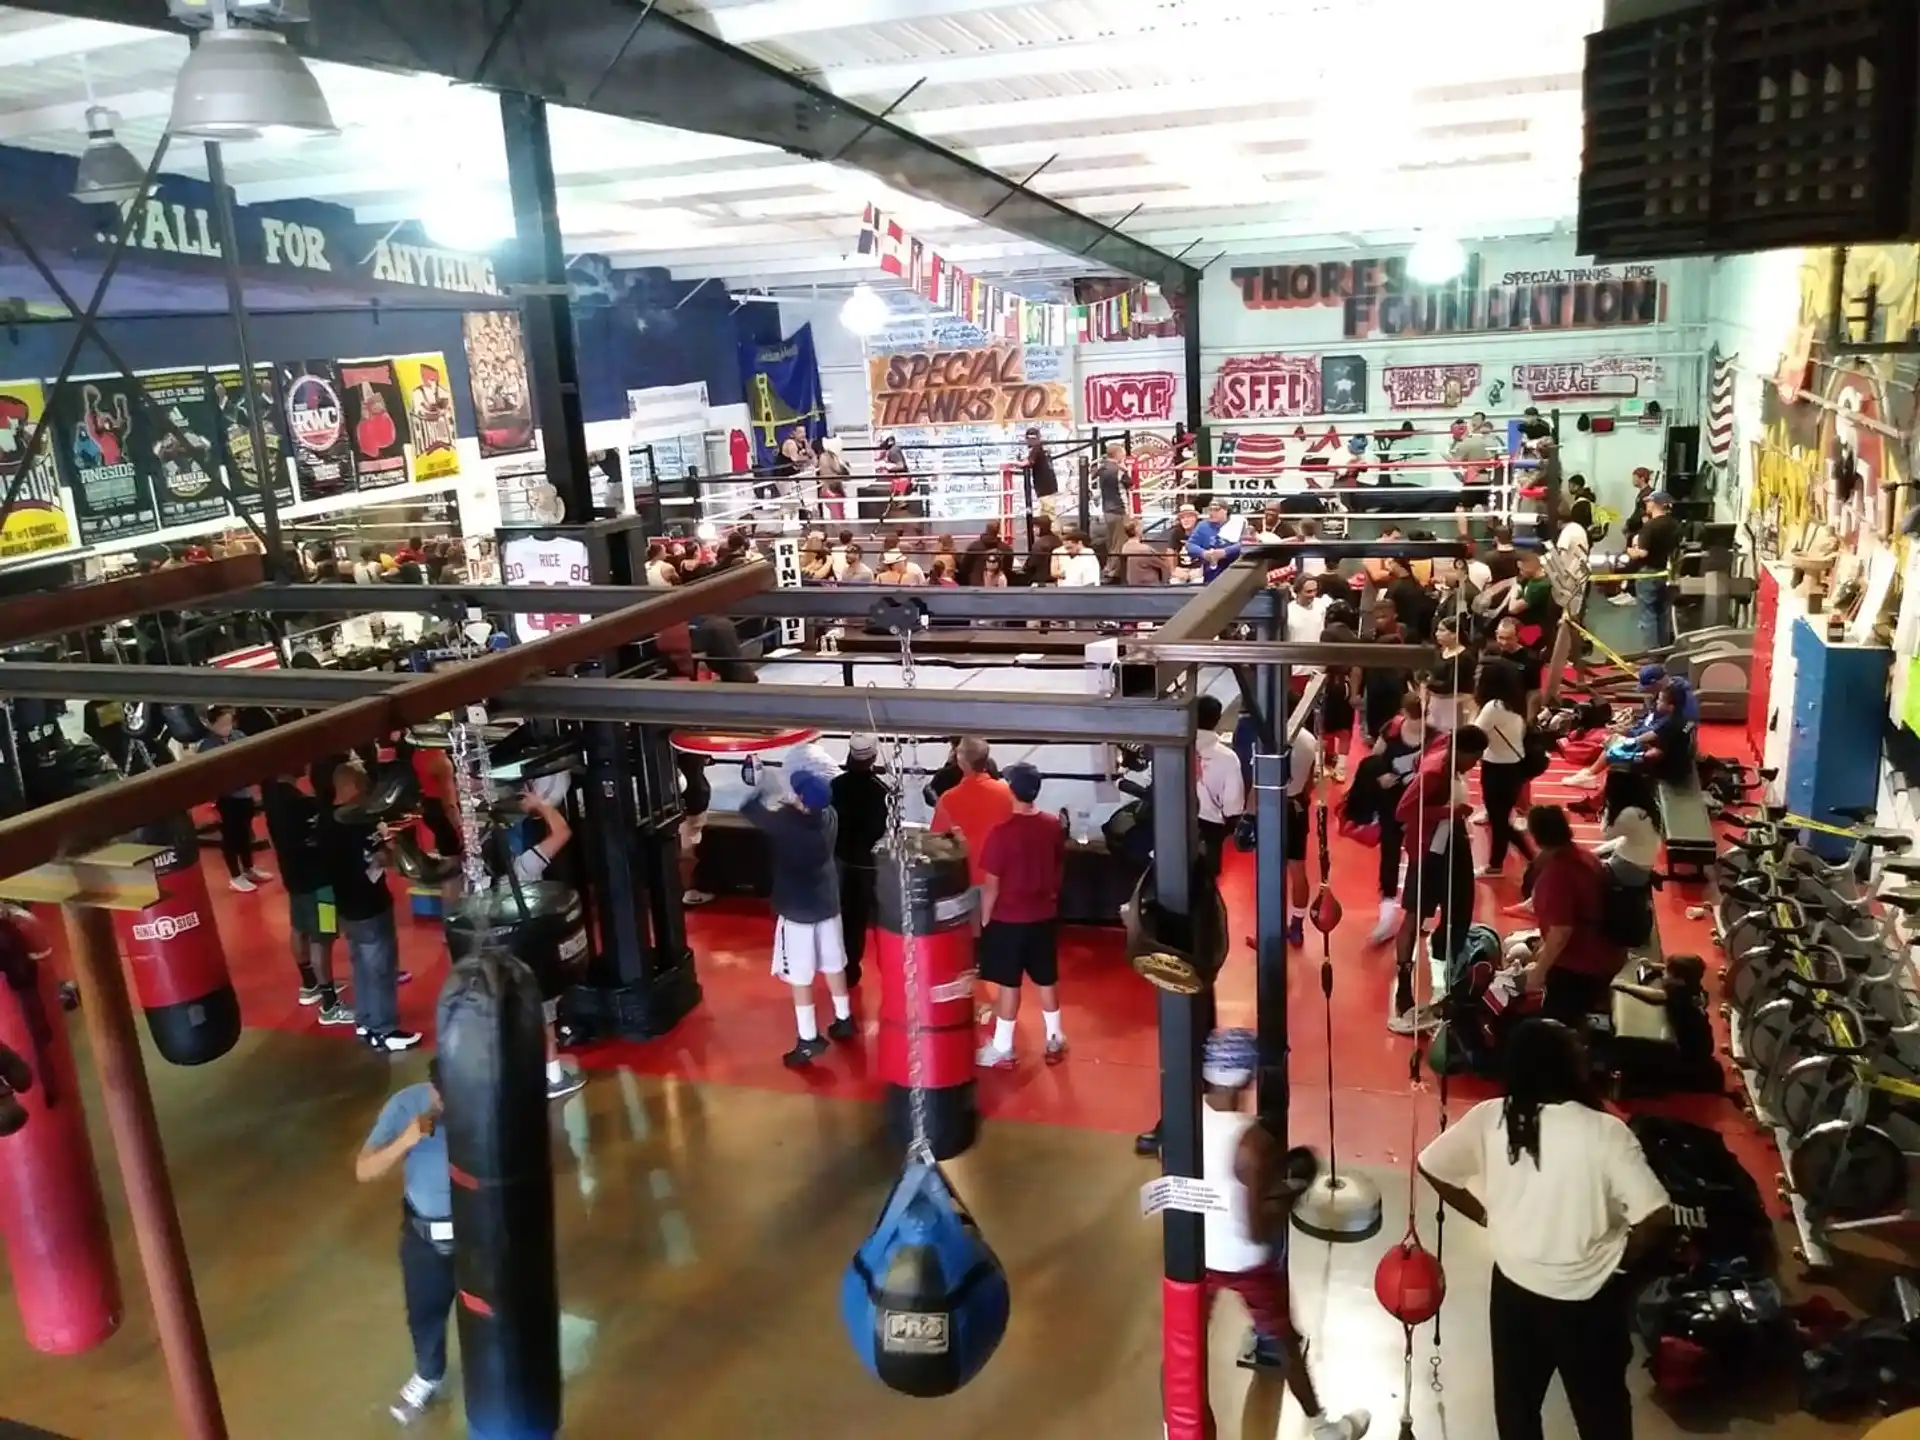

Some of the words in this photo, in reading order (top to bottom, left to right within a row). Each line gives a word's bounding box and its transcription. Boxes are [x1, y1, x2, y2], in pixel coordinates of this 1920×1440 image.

[261, 217, 332, 272] FOR
[1502, 268, 1561, 286] SPECIAL
[1563, 266, 1613, 283] THANKS
[886, 346, 1026, 391] SPECIAL
[1517, 366, 1579, 383] SUNSET
[1535, 378, 1599, 393] GARAGE
[877, 384, 997, 426] THANKS
[1094, 380, 1170, 421] DCYF
[539, 553, 562, 567] RICE
[505, 562, 524, 581] 80
[570, 563, 592, 582] 80
